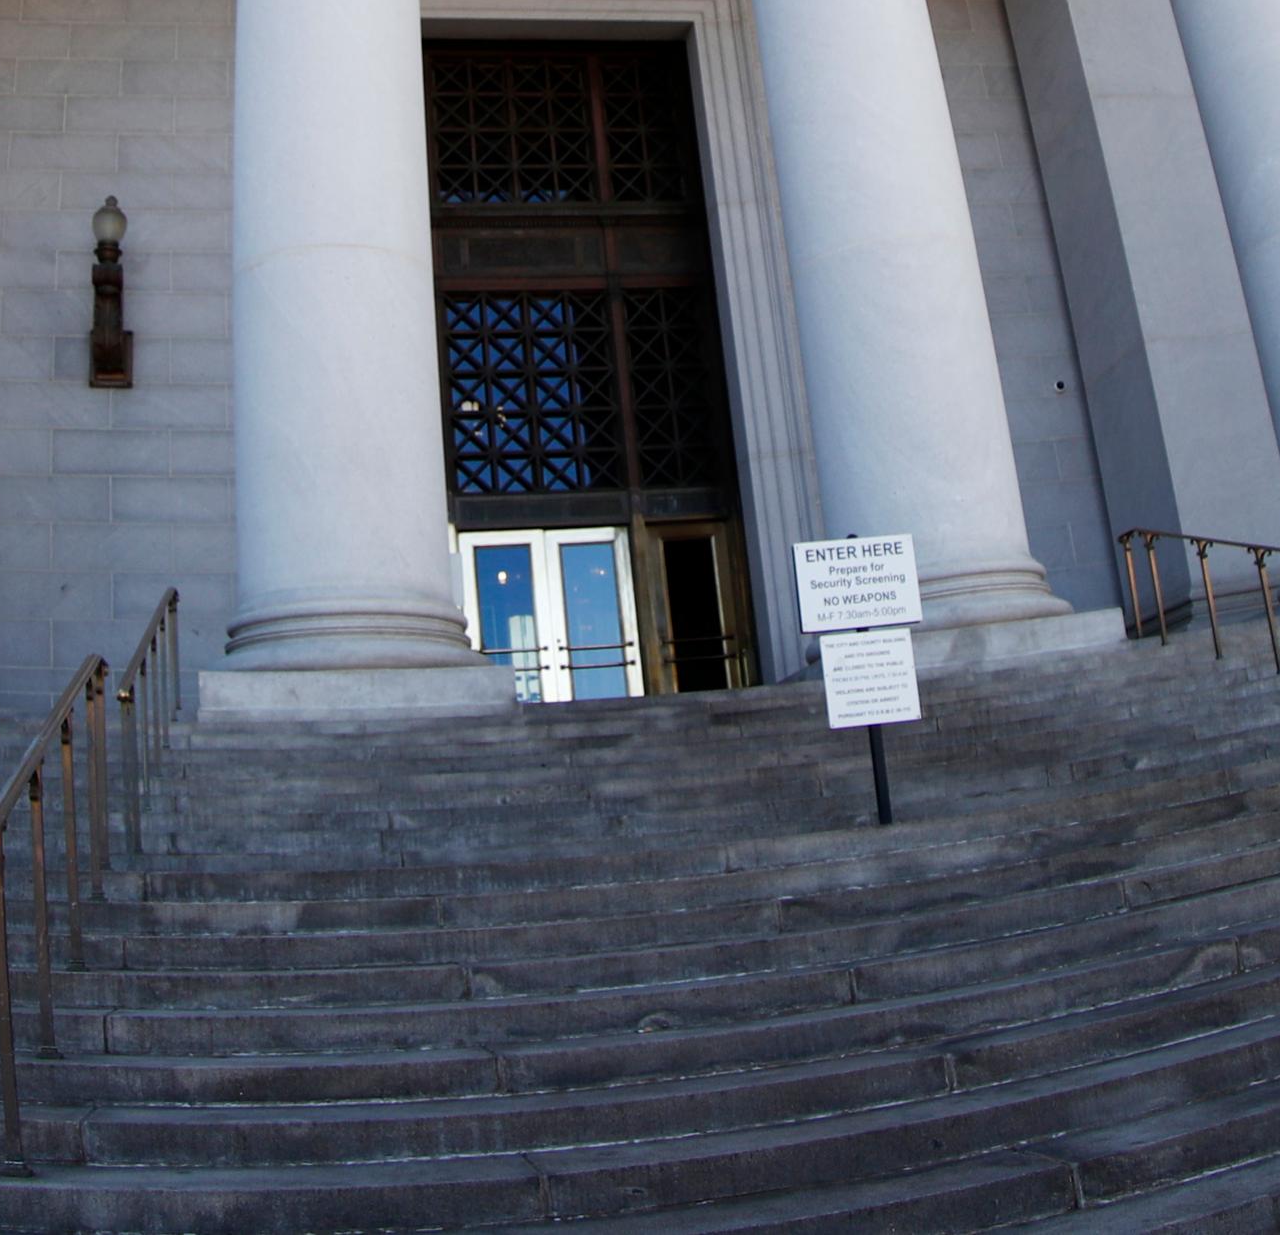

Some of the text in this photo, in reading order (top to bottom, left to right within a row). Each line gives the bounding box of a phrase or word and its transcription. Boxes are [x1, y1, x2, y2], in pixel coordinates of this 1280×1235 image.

[805, 541, 904, 563] ENTER HERE
[829, 563, 885, 576] Prepare for
[810, 574, 906, 590] Security Screening
[824, 591, 897, 606] NO WEAPONS
